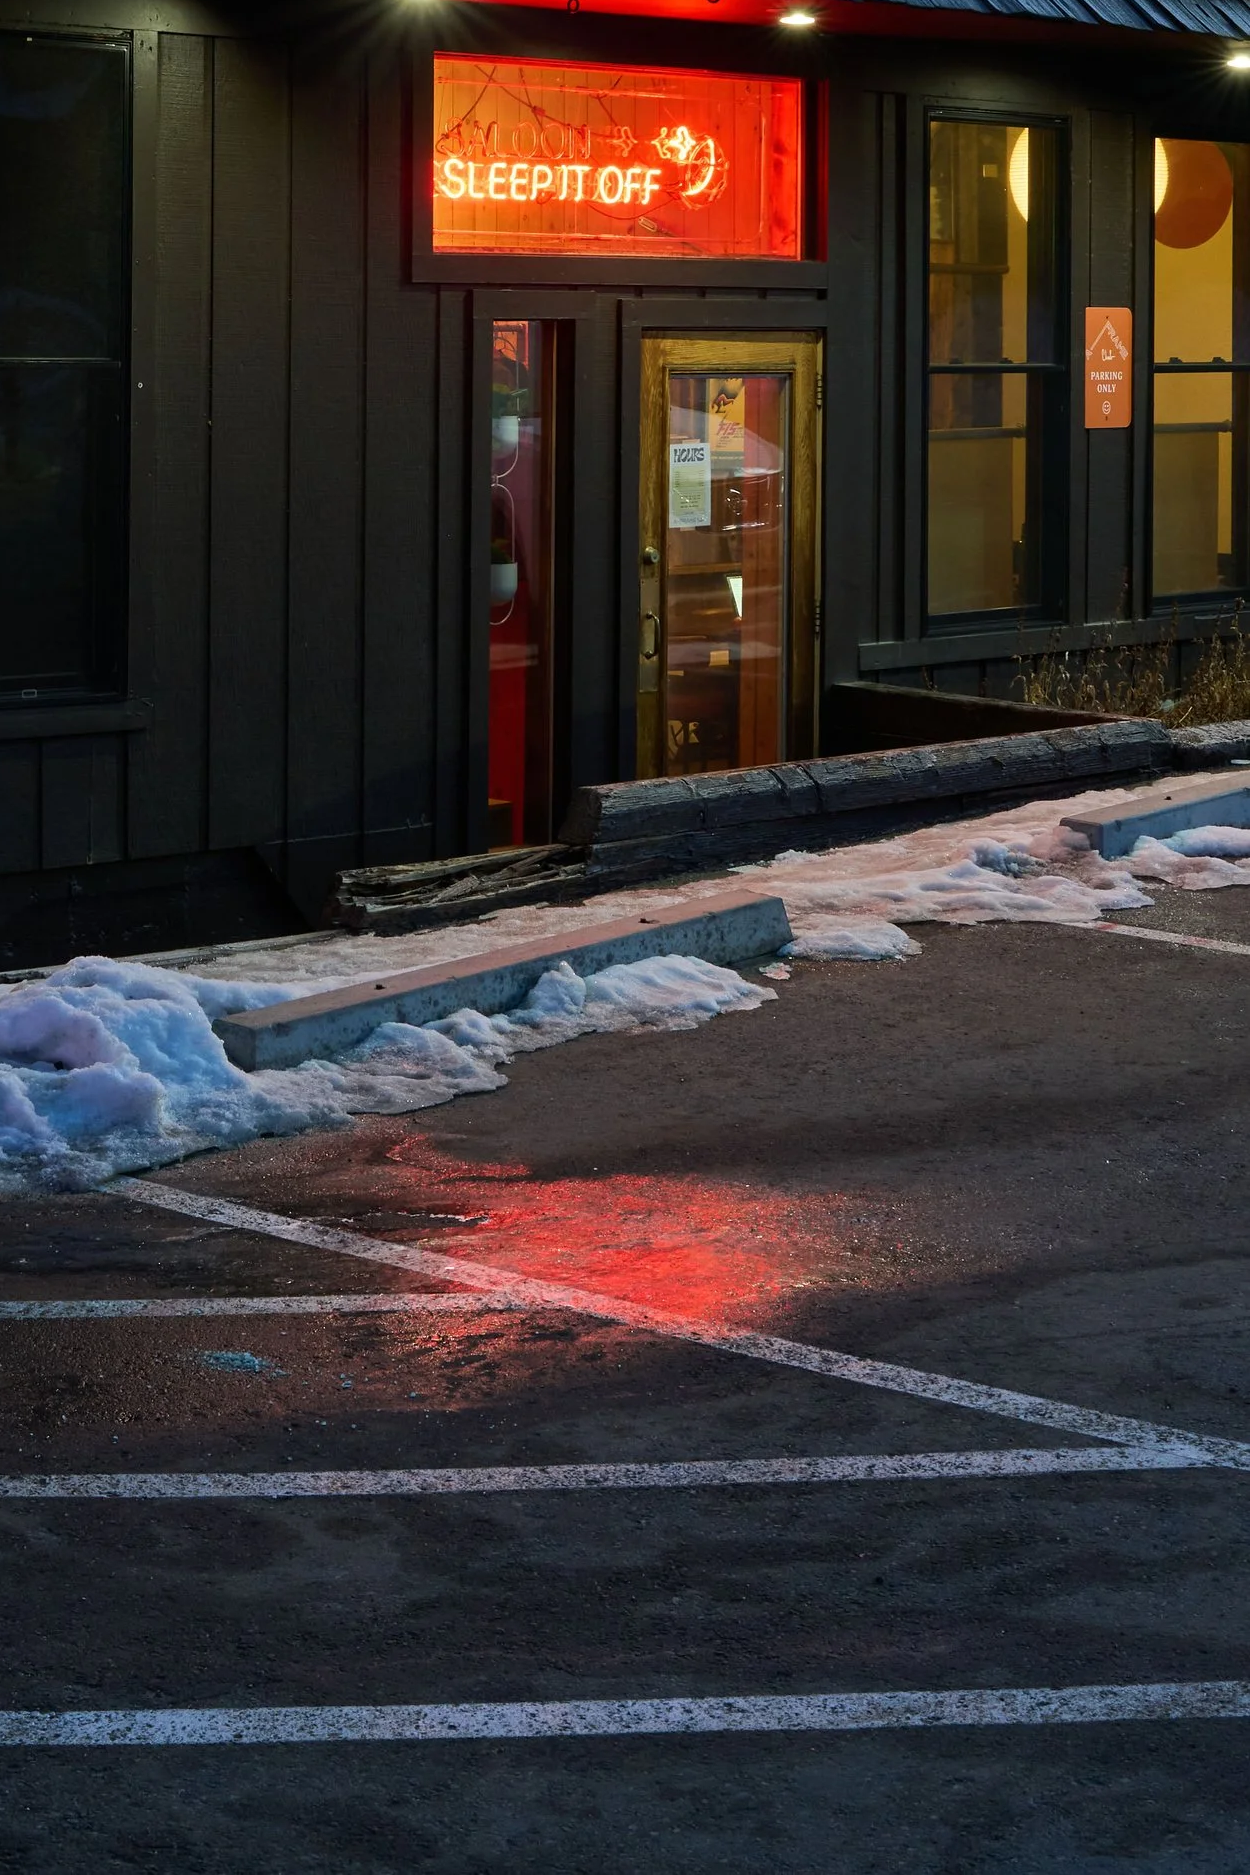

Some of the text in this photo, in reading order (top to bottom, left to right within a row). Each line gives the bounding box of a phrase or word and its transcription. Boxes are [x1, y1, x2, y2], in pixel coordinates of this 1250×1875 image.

[436, 117, 591, 159] SALOON
[439, 158, 662, 205] SLEEP IT OFF
[1090, 371, 1123, 381] PARKING
[1097, 383, 1116, 393] ONLY
[673, 447, 705, 463] HOURS
